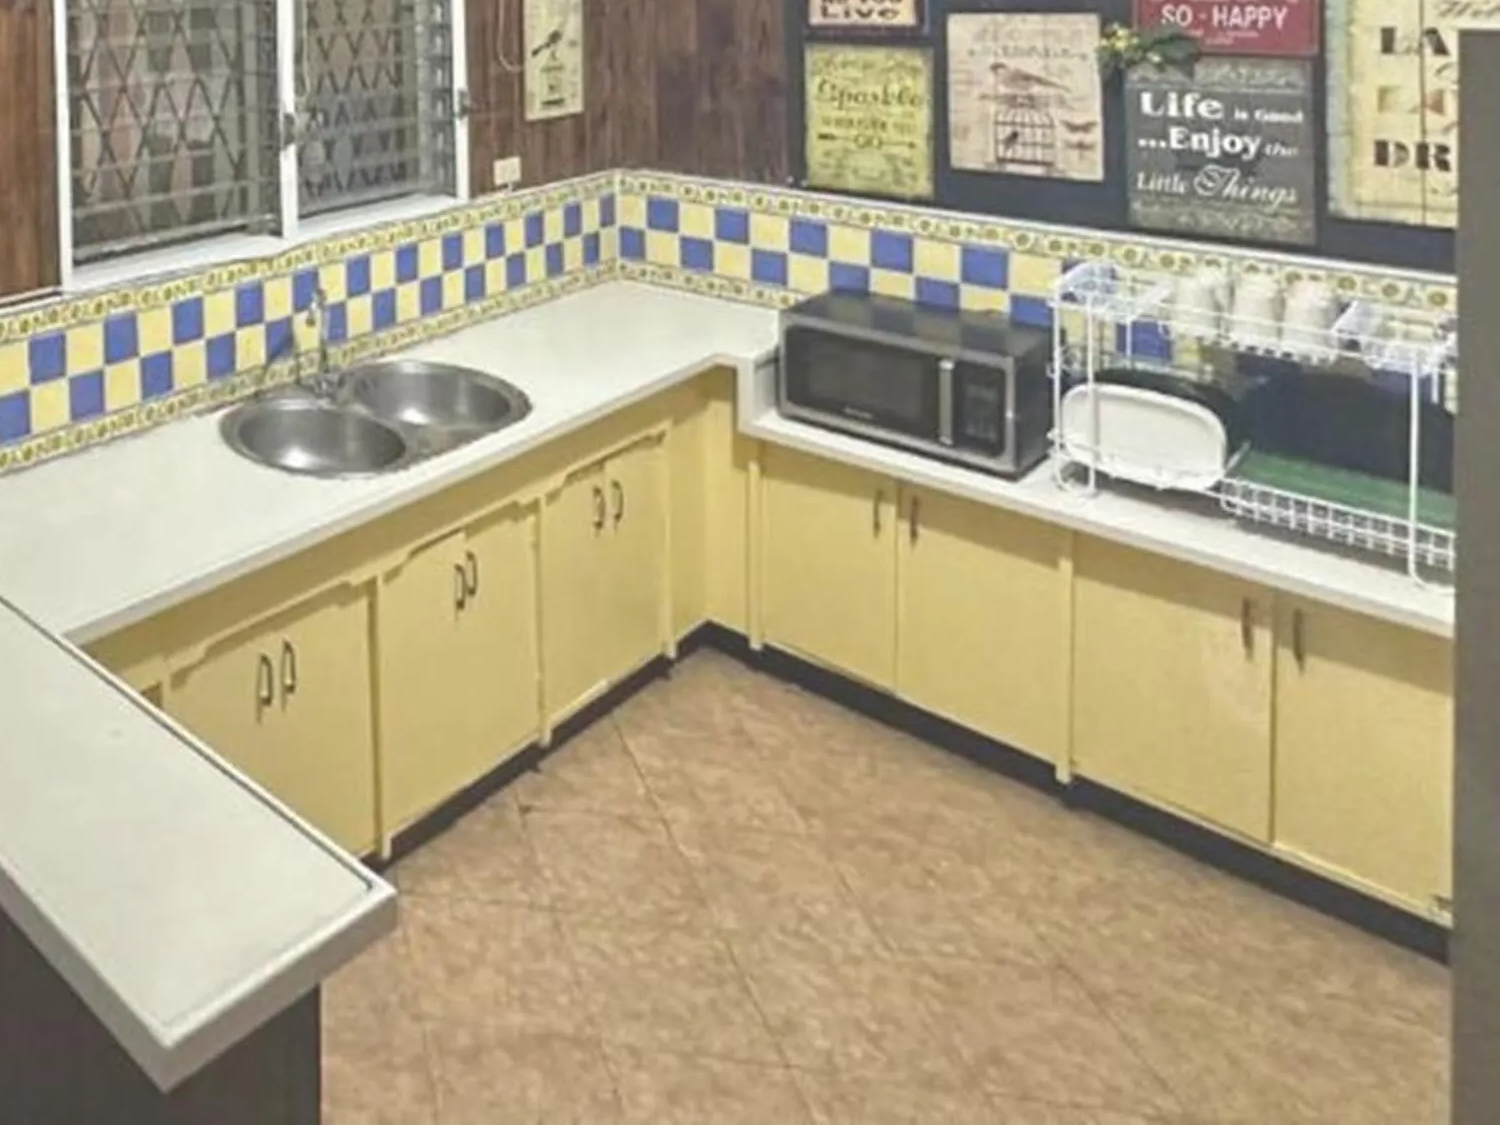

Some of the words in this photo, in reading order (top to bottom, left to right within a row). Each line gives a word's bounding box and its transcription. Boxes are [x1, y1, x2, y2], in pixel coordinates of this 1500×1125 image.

[1161, 4, 1192, 26] SO
[1212, 4, 1288, 29] HAPPY
[1139, 90, 1224, 121] Life
[1136, 170, 1189, 196] Little
[1193, 161, 1299, 214] Things
